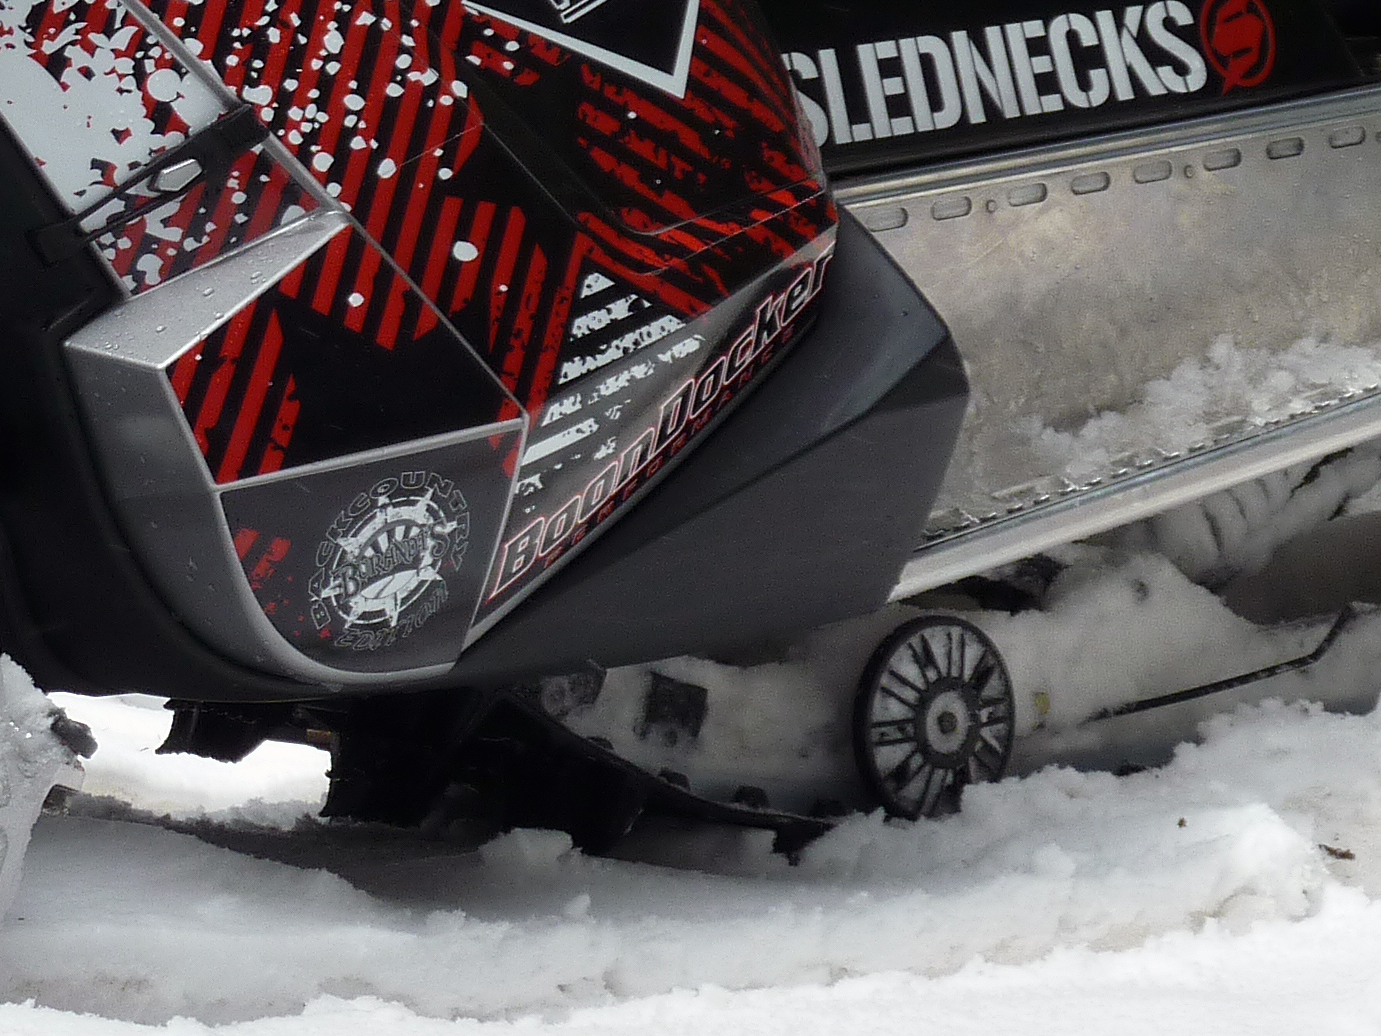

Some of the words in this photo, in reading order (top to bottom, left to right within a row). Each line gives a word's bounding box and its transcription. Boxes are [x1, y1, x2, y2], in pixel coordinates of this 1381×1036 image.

[782, 0, 1207, 148] SLEDNECKS
[543, 323, 795, 571] PERFORMANCE
[308, 471, 470, 630] BACKCOUNTRY
